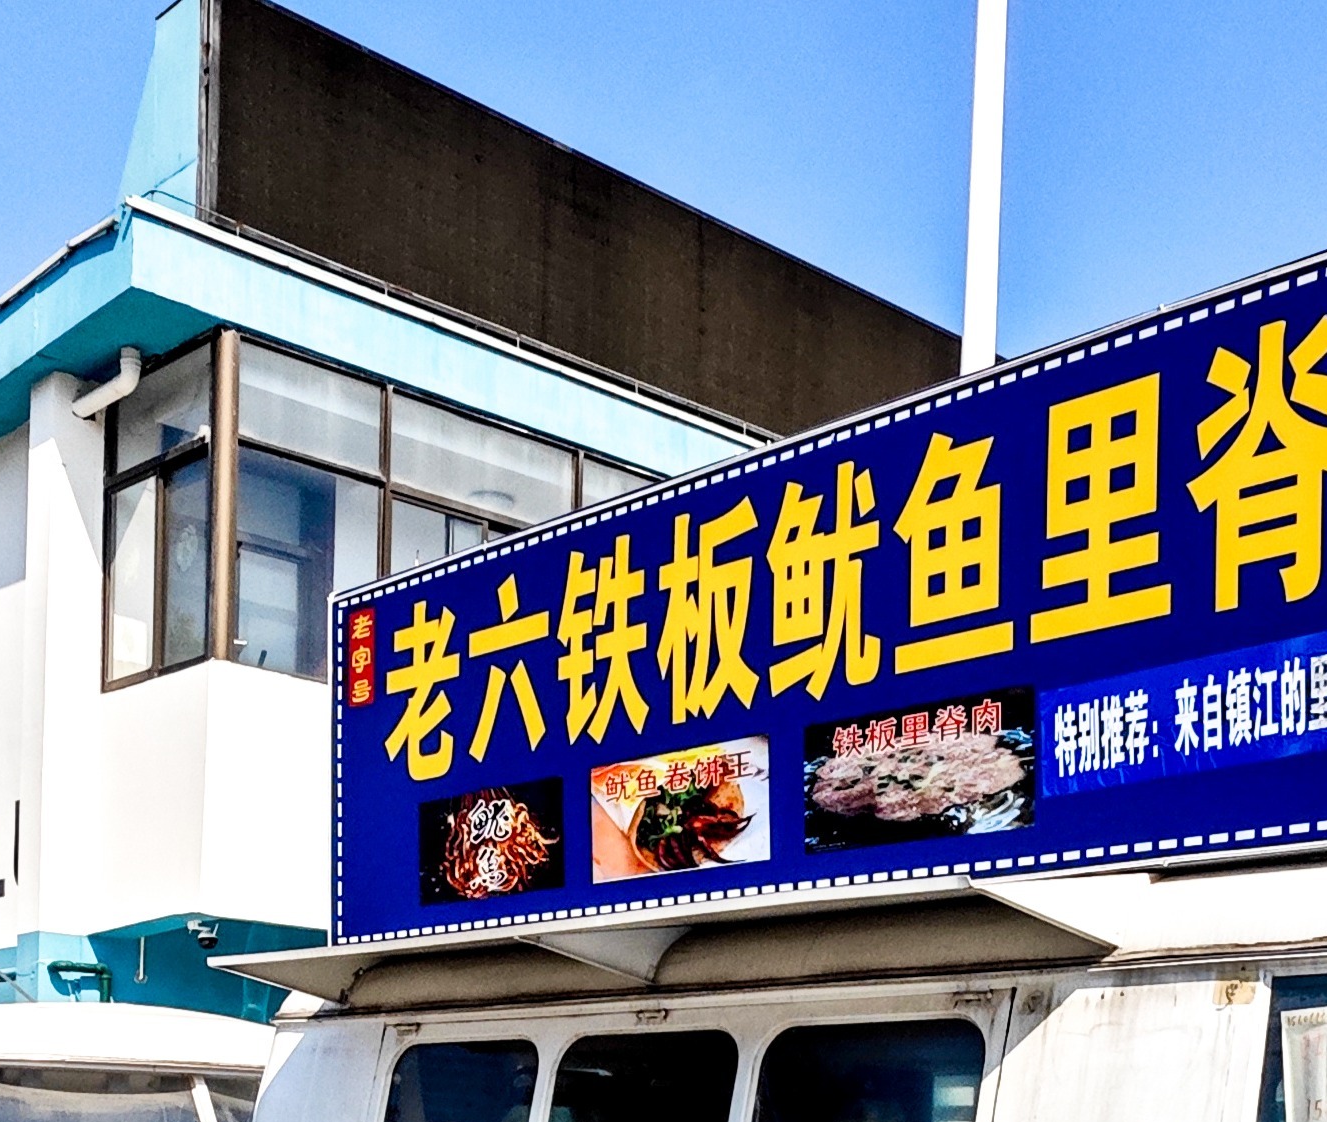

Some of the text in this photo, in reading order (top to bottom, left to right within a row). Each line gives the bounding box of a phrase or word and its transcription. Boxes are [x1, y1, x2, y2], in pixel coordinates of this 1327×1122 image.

[350, 614, 373, 704] 老字号
[832, 698, 1003, 759] 铁板里脊肉
[605, 749, 757, 803] 鱿鱼卷饼王
